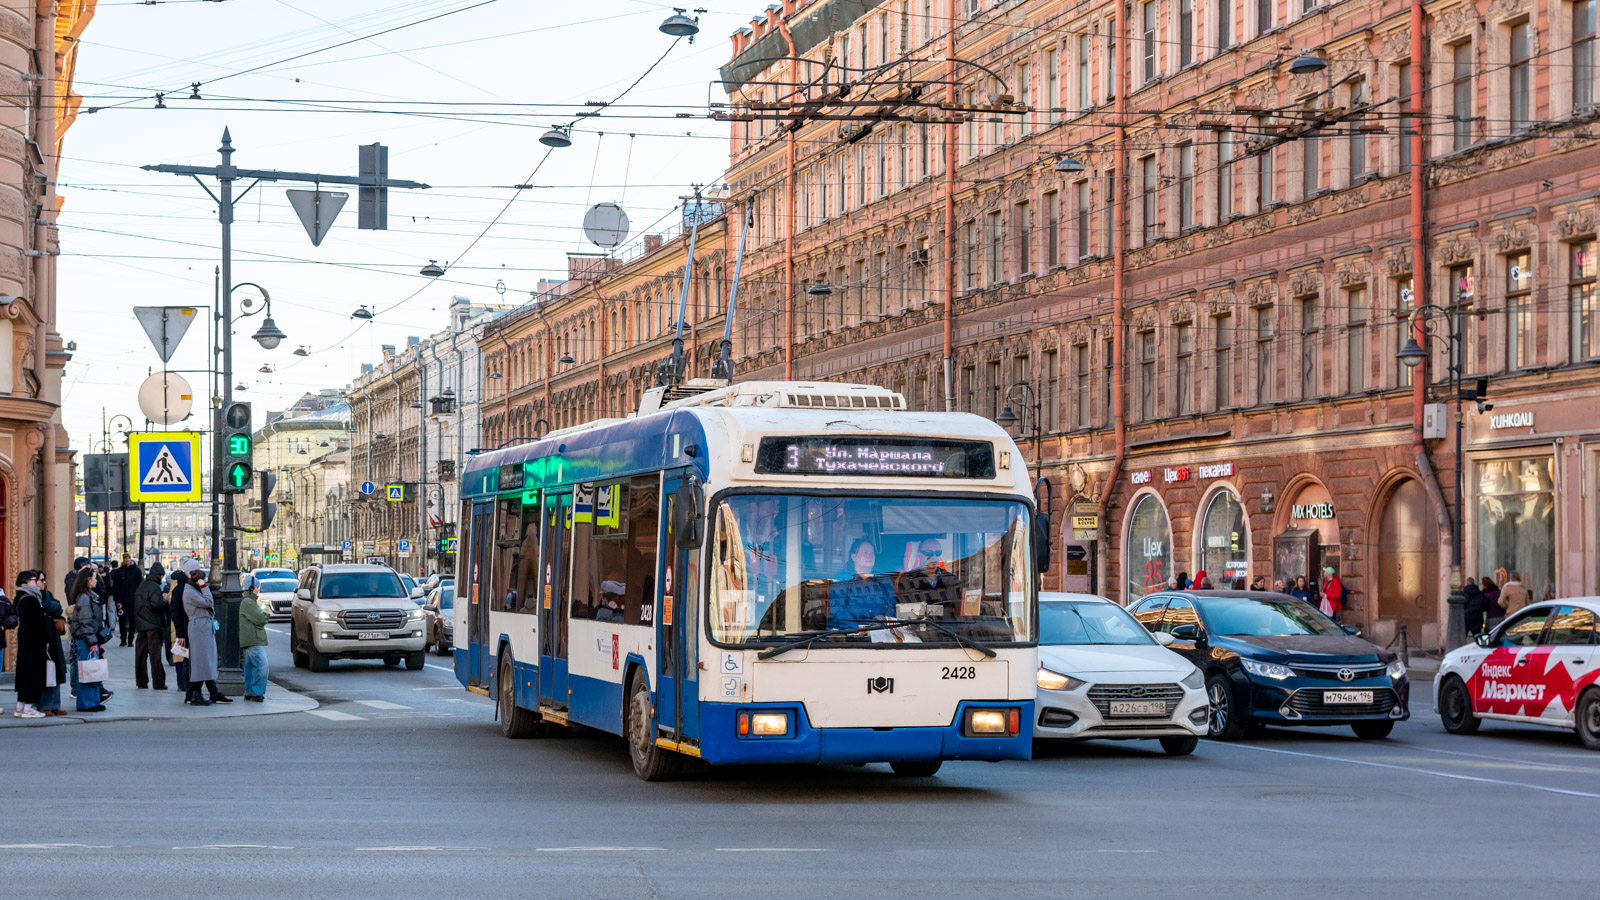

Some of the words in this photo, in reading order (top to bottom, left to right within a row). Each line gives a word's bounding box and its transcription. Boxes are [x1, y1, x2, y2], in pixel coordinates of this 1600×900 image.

[230, 437, 248, 455] 30
[825, 447, 853, 459] Ул.
[857, 447, 932, 461] Маршала
[787, 444, 799, 469] 3
[816, 458, 944, 472] Тухачевского
[1131, 471, 1151, 484] кафе
[1199, 463, 1234, 479] пекарня
[1292, 505, 1304, 519] MIX
[1306, 503, 1333, 519] HOTELS
[1143, 538, 1163, 561] Цех
[1144, 561, 1163, 595] 85
[641, 604, 653, 621] 2428
[941, 666, 976, 680] 2428
[1481, 662, 1512, 679] Яндекс
[1481, 680, 1546, 703] Маркет
